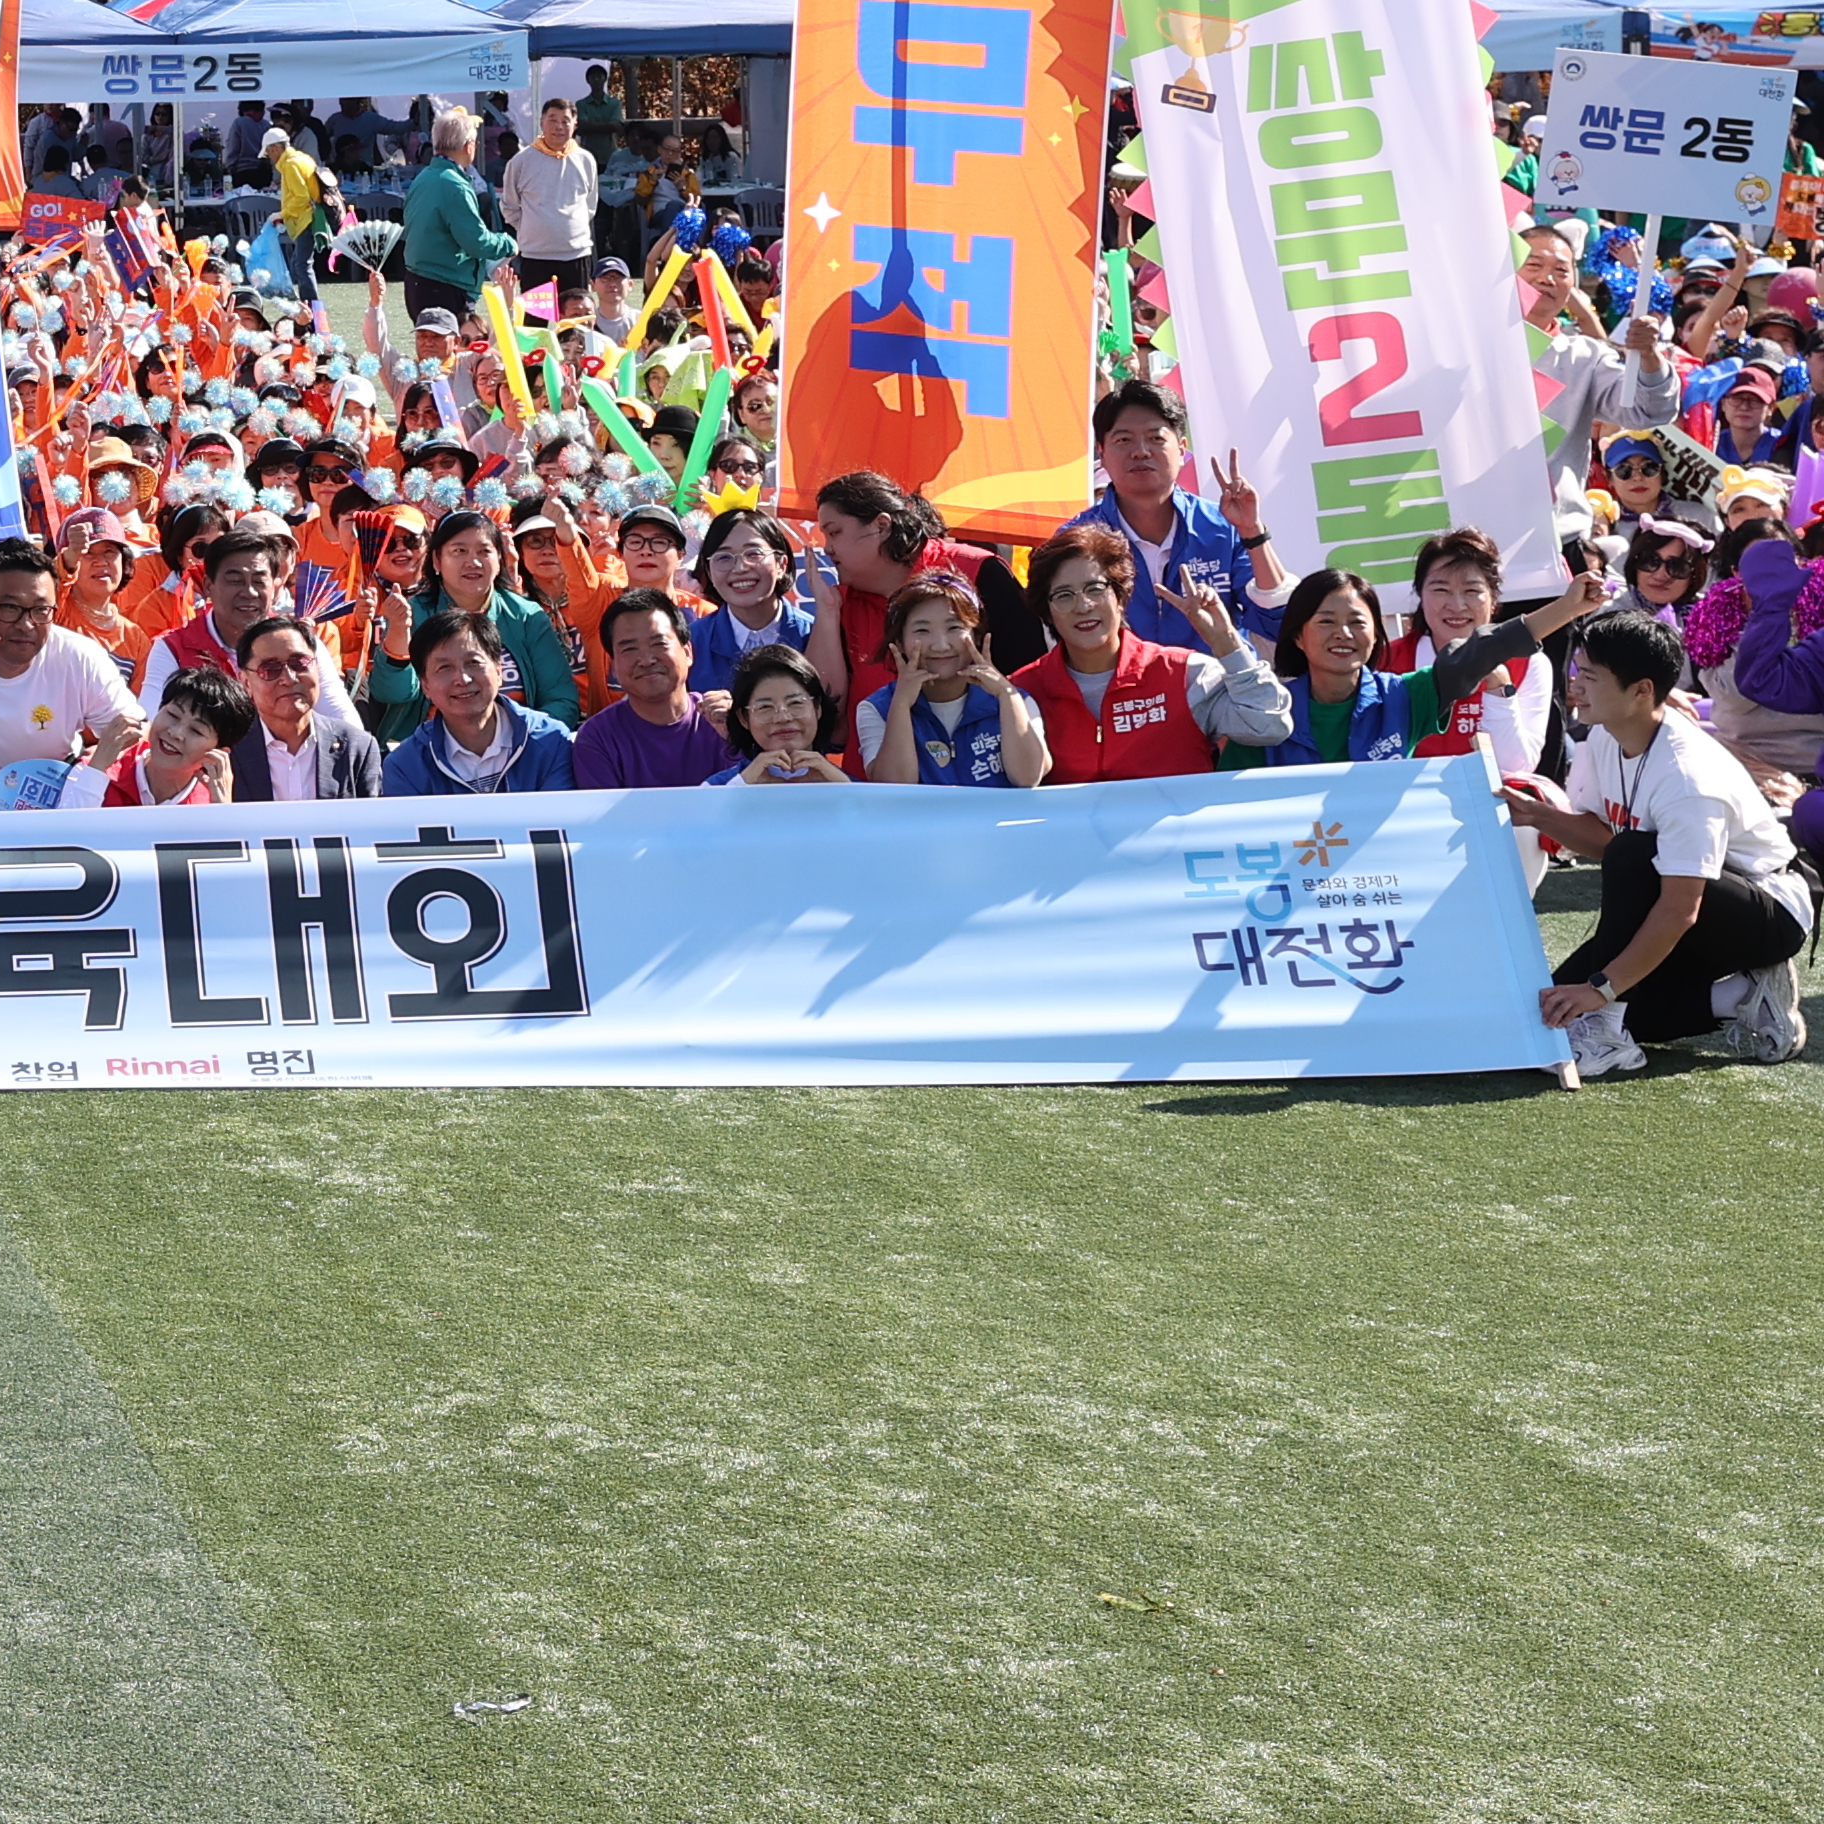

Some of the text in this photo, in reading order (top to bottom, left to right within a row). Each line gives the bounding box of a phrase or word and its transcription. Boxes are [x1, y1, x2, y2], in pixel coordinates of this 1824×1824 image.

[102, 52, 264, 95] 쌍문2동
[469, 64, 513, 82] 대전환
[1579, 104, 1755, 163] 쌍문 2동
[30, 202, 62, 218] GO!
[1246, 30, 1452, 585] 쌍문2동
[1112, 694, 1166, 714] 도봉구의원
[1112, 705, 1167, 734] 김명화
[1183, 841, 1292, 922] 도봉
[1301, 874, 1399, 892] 문화와 경제가
[1316, 891, 1402, 909] 살아 숨 쉬는
[1192, 917, 1416, 995] 대전환
[105, 1054, 221, 1077] Rinnai
[246, 1049, 317, 1076] 명진
